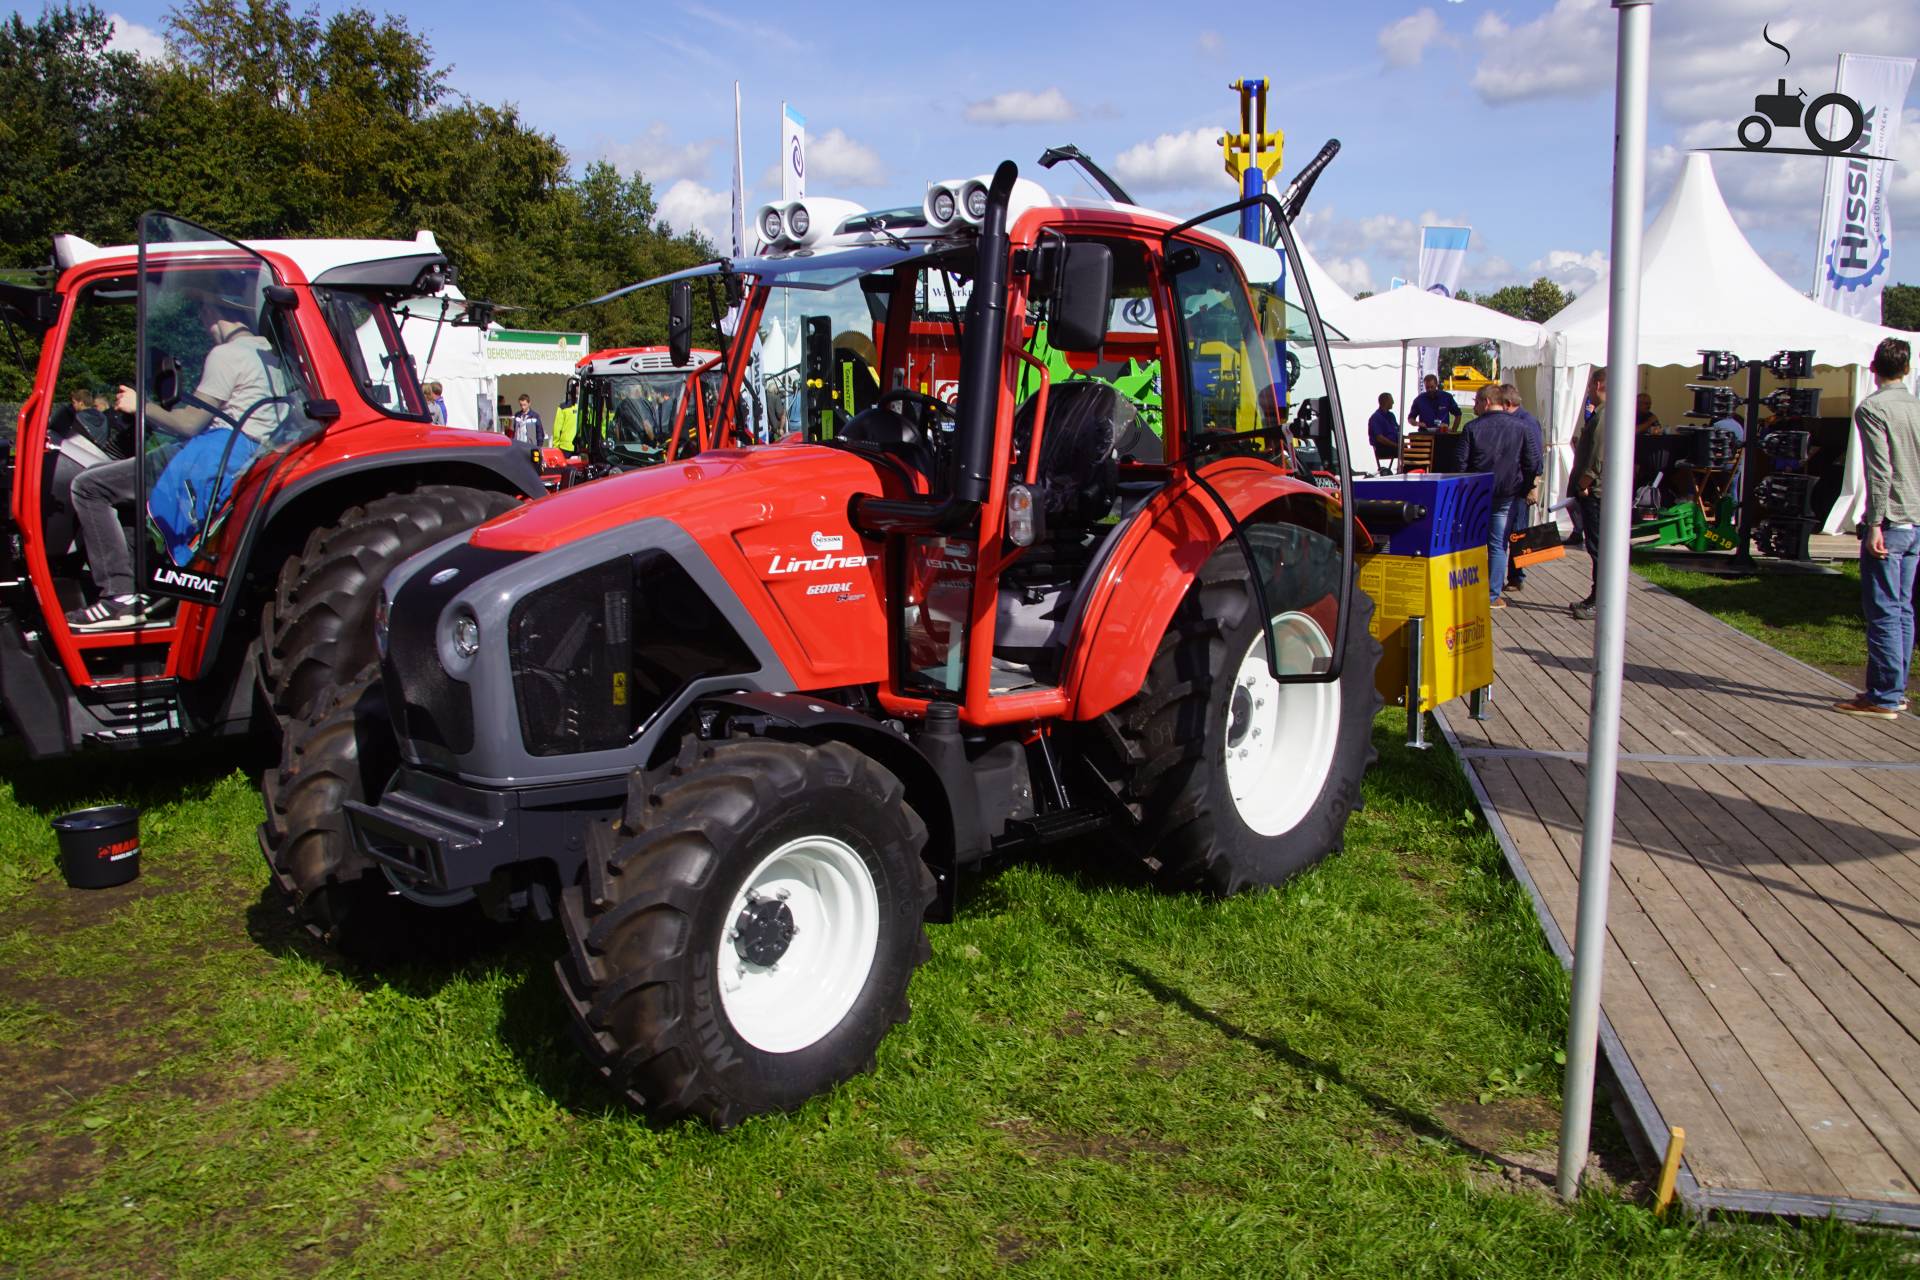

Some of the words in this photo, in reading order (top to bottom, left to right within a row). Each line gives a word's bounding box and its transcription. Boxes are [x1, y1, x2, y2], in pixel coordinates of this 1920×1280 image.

[767, 553, 879, 575] Lindner
[153, 567, 219, 594] LINTRAC
[806, 582, 853, 596] GEOTRAC
[1448, 566, 1480, 591] M490X
[691, 951, 744, 1073] MITAS
